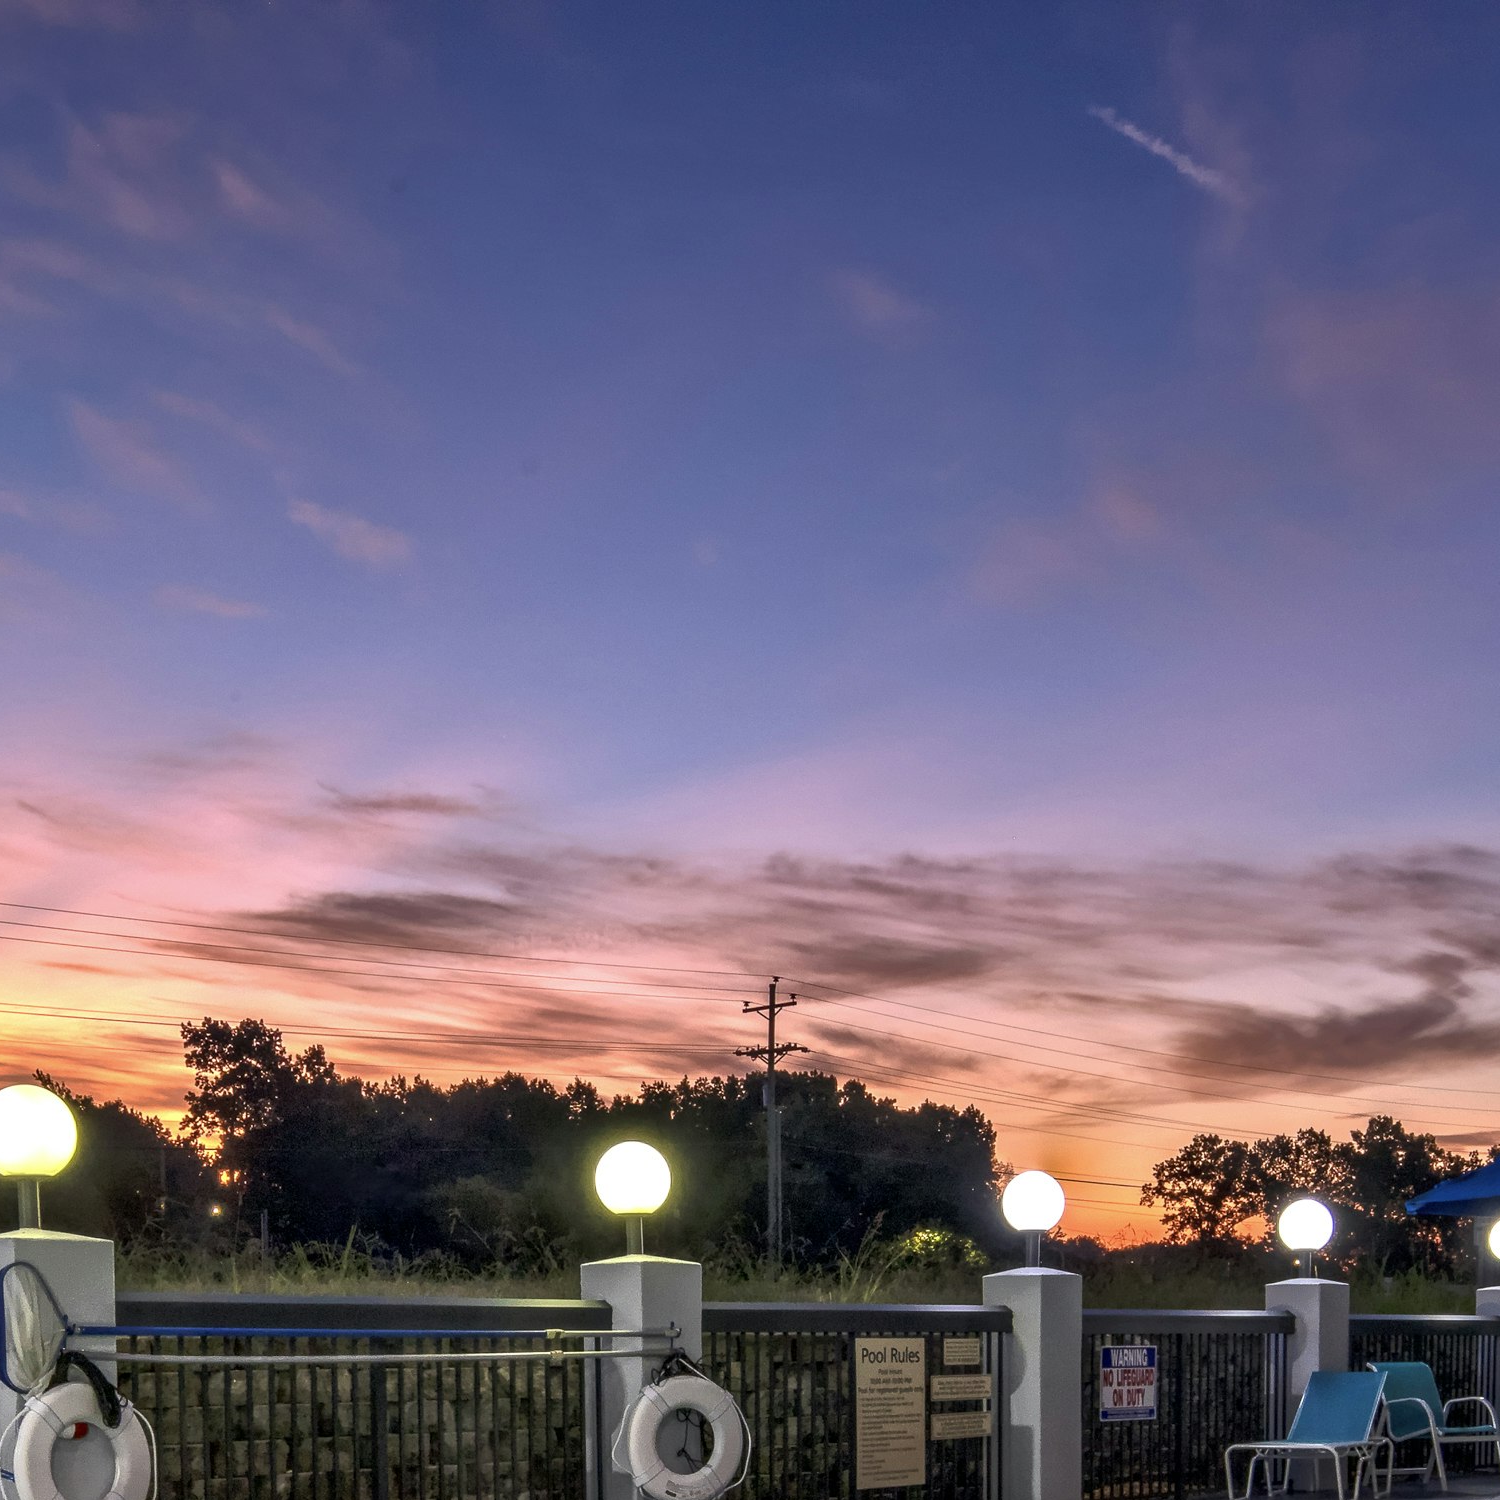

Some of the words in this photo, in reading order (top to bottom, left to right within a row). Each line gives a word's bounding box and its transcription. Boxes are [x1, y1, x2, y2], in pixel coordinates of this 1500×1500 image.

[861, 1346, 887, 1364] Pool
[890, 1346, 920, 1363] Rules
[1110, 1348, 1149, 1367] WARNING
[1103, 1369, 1114, 1387] NO
[1116, 1368, 1154, 1387] LIFEGUARD
[1112, 1388, 1124, 1407] ON
[1126, 1387, 1146, 1406] DUTY
